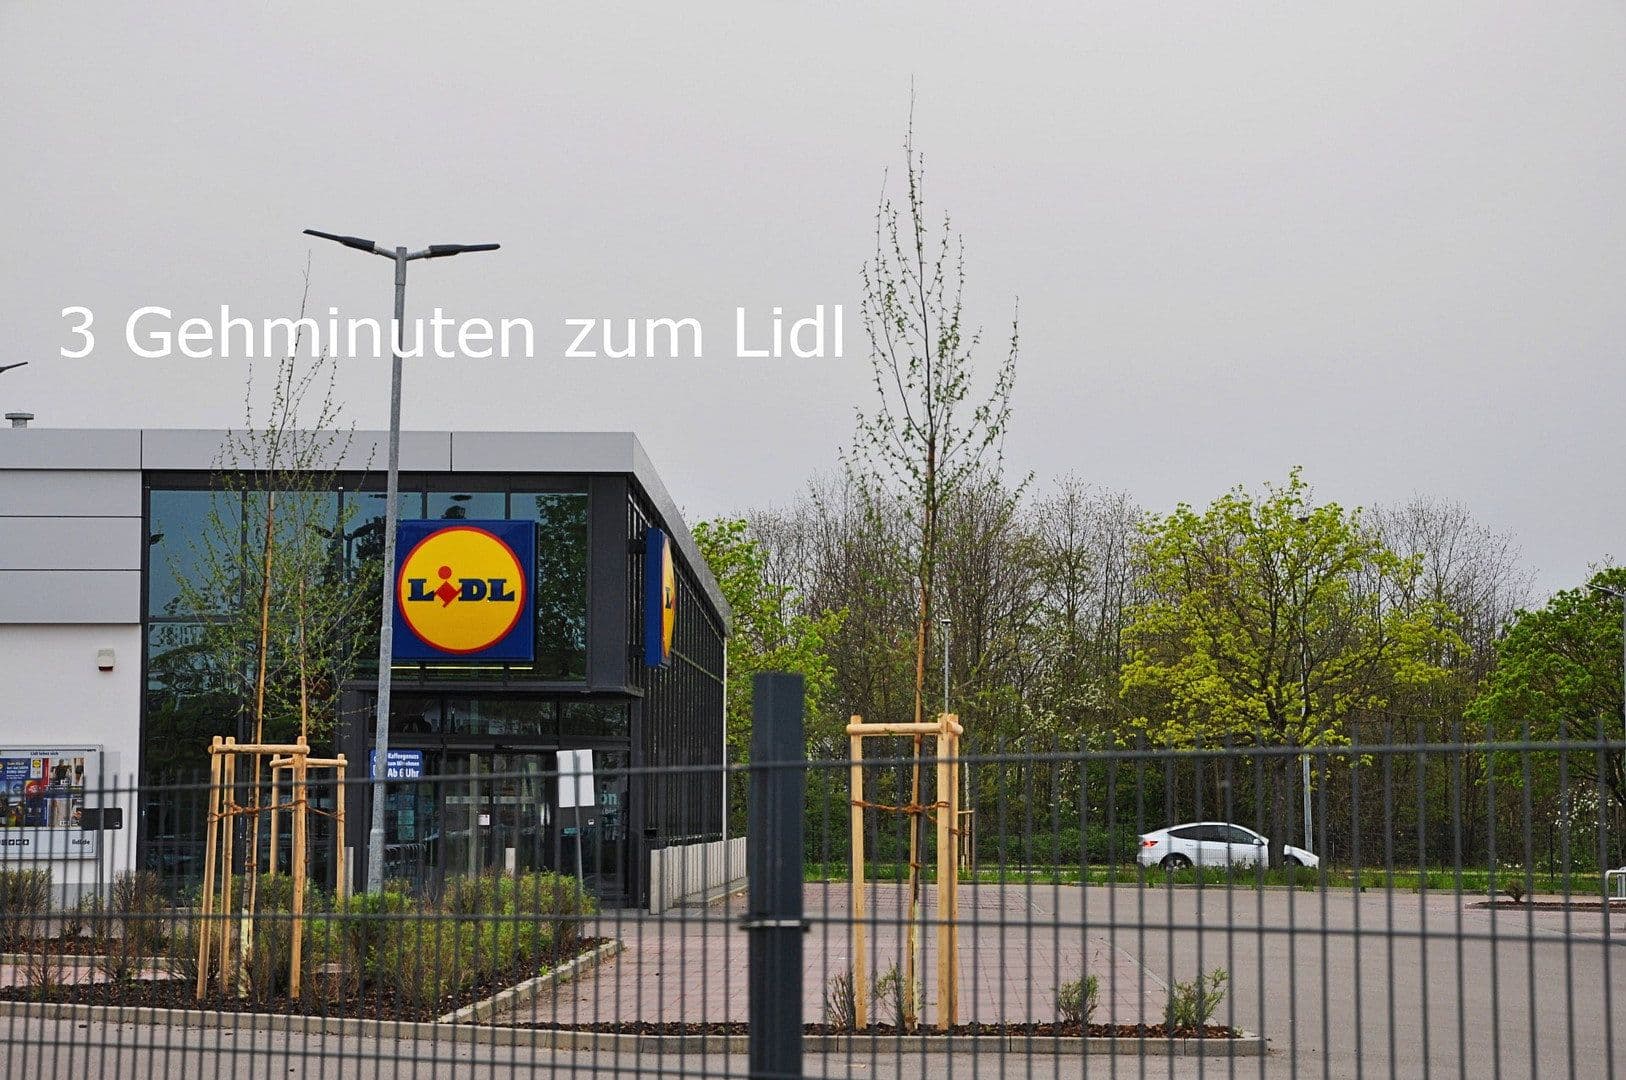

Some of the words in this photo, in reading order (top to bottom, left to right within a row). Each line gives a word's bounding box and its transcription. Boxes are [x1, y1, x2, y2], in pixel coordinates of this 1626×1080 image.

[407, 566, 515, 608] LIDL
[387, 768, 398, 777] Ab
[405, 768, 419, 777] Uhr
